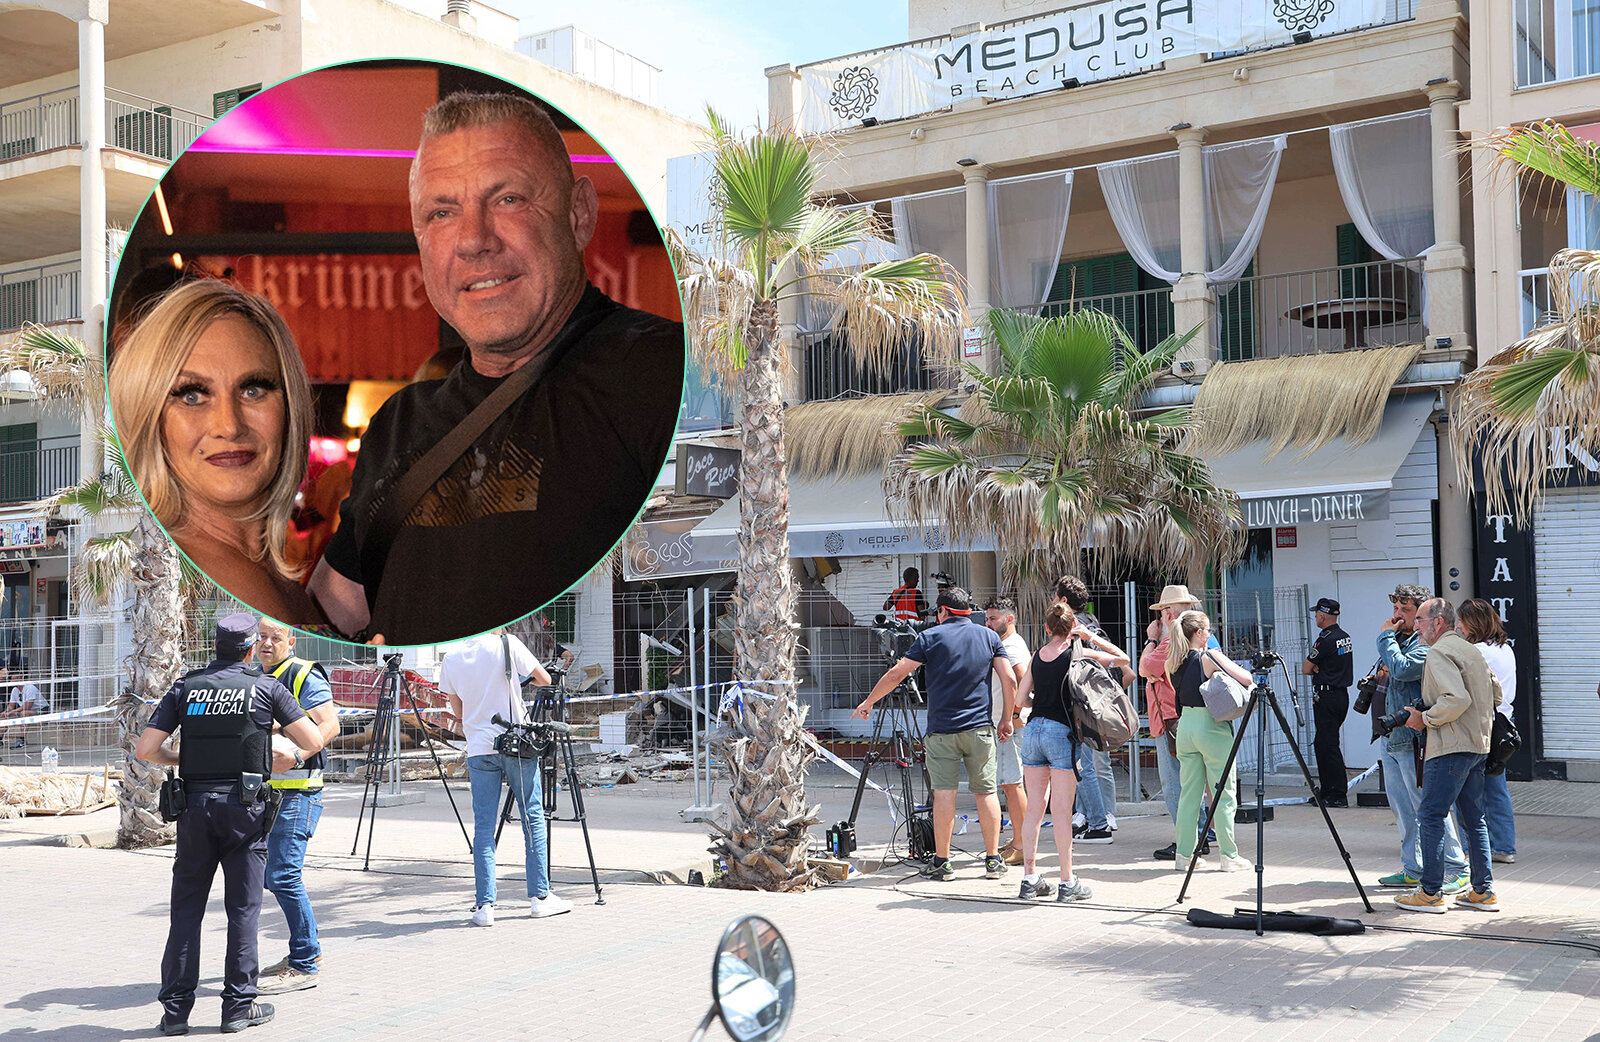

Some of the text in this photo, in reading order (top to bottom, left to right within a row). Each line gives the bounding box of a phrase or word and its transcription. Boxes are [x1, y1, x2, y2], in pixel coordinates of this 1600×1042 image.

[934, 0, 1193, 80] MEDUSA
[950, 36, 1175, 97] BEACH CLUB
[251, 253, 428, 311] krüme
[687, 452, 715, 485] Coco
[704, 463, 736, 494] Rico
[1247, 493, 1365, 527] LUNCH-DINER
[858, 534, 909, 545] MEDUSA
[186, 688, 246, 703] POLICIA
[205, 701, 244, 715] LOCAL
